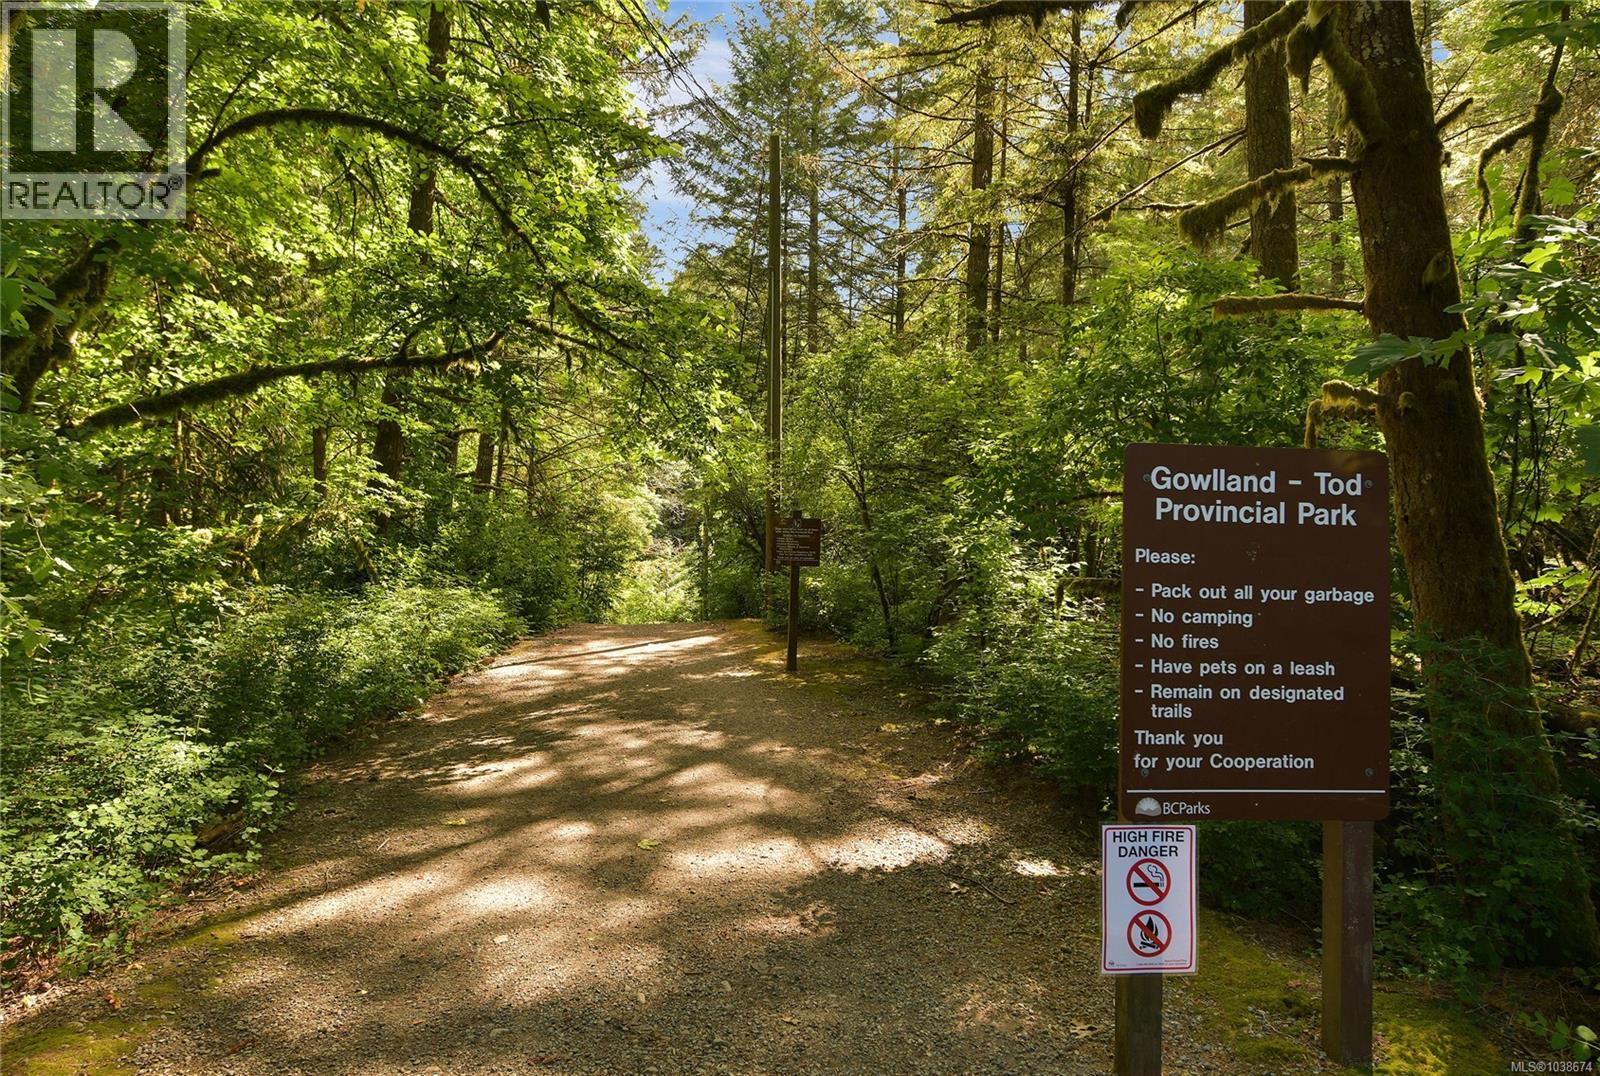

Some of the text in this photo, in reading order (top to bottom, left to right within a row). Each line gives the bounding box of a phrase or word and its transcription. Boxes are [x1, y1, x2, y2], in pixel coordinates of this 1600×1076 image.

[1149, 465, 1276, 494] Gowlland
[1313, 471, 1362, 496] Tod
[1155, 497, 1358, 527] Provincial Park
[1135, 547, 1196, 565] Please:
[1151, 582, 1192, 599] Pack
[1198, 585, 1227, 600] out
[1233, 584, 1253, 600] all
[1260, 588, 1298, 603] your
[1304, 586, 1375, 606] garbage
[1151, 607, 1175, 624] No
[1181, 609, 1253, 628] camping
[1151, 633, 1175, 649] No
[1181, 633, 1219, 650] fires
[1151, 658, 1193, 674] Have
[1199, 660, 1237, 677] pets
[1244, 663, 1266, 675] on
[1272, 663, 1283, 675] a
[1290, 661, 1335, 676] leash
[1150, 683, 1213, 700] Remain
[1219, 687, 1241, 700] on
[1249, 684, 1345, 704] designated
[1150, 703, 1193, 719] trails
[1133, 729, 1224, 748] Thank you
[1133, 753, 1315, 772] for your Cooperation
[1112, 830, 1185, 843] HIGH FIRE
[1118, 845, 1179, 858] DANGER
